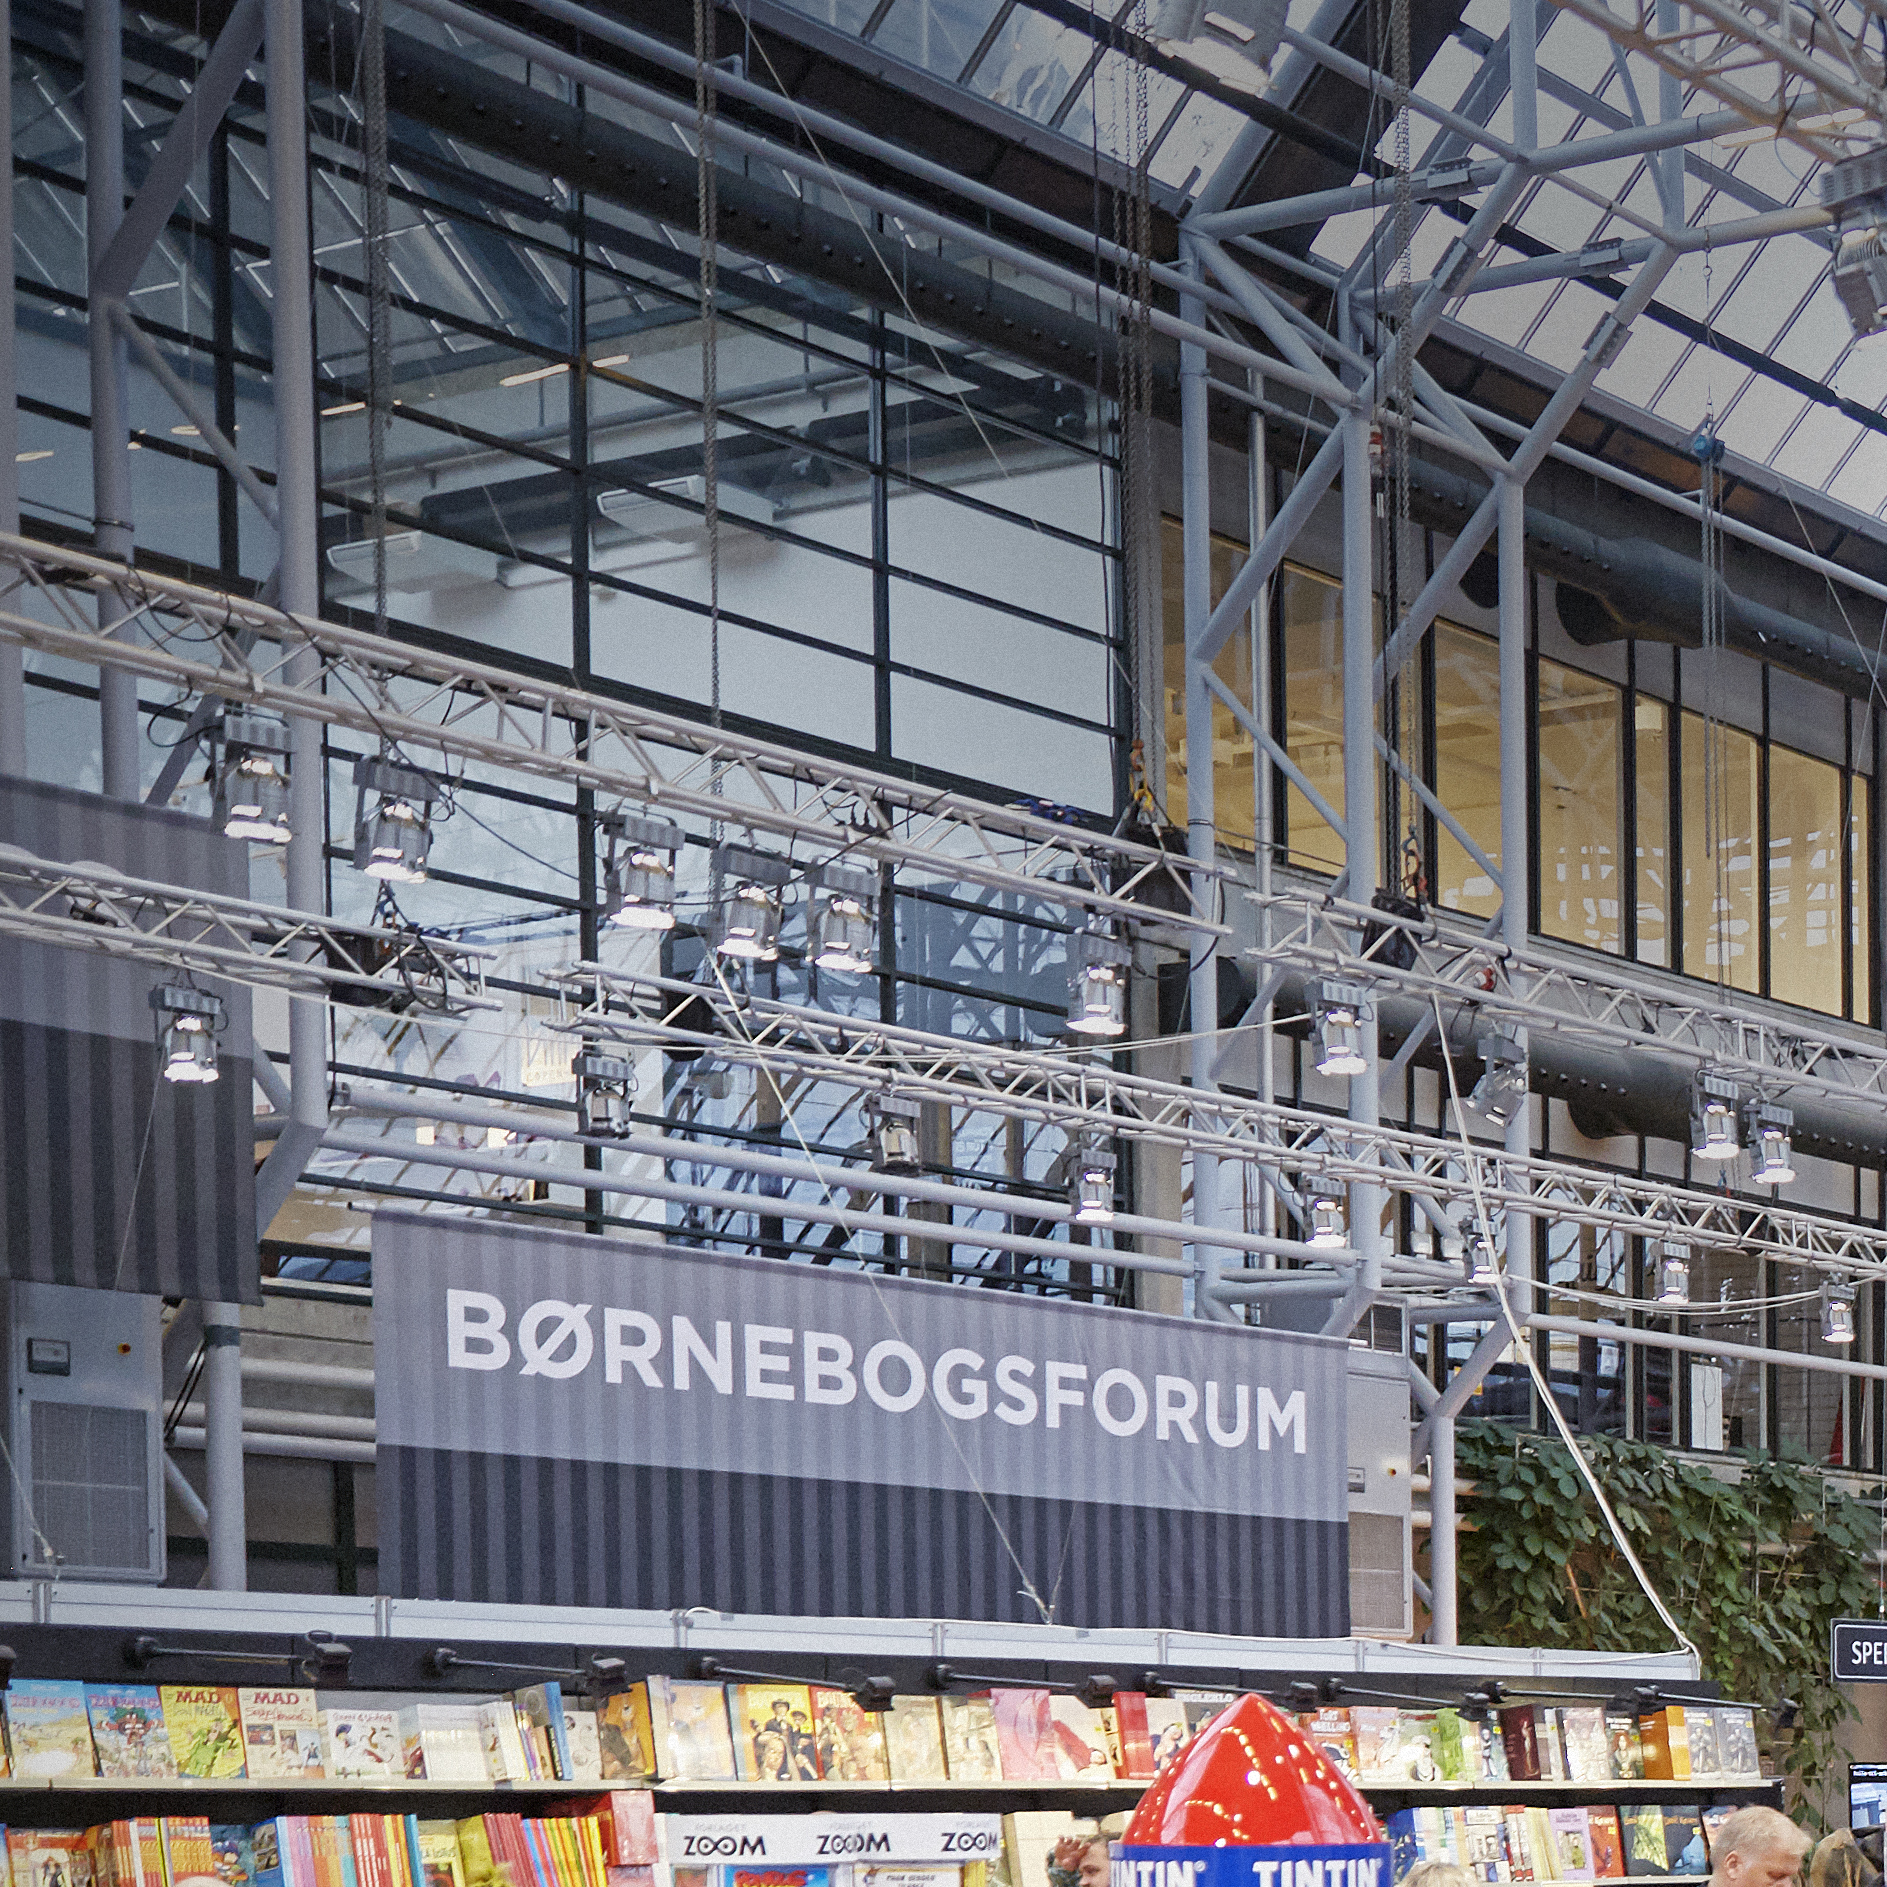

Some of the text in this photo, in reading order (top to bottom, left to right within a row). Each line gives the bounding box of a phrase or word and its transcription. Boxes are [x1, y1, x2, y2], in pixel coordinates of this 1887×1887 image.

[446, 1287, 1308, 1455] BØRNEBOGSFORUM
[683, 1835, 767, 1857] ZOOM
[816, 1833, 891, 1855] ZOOM
